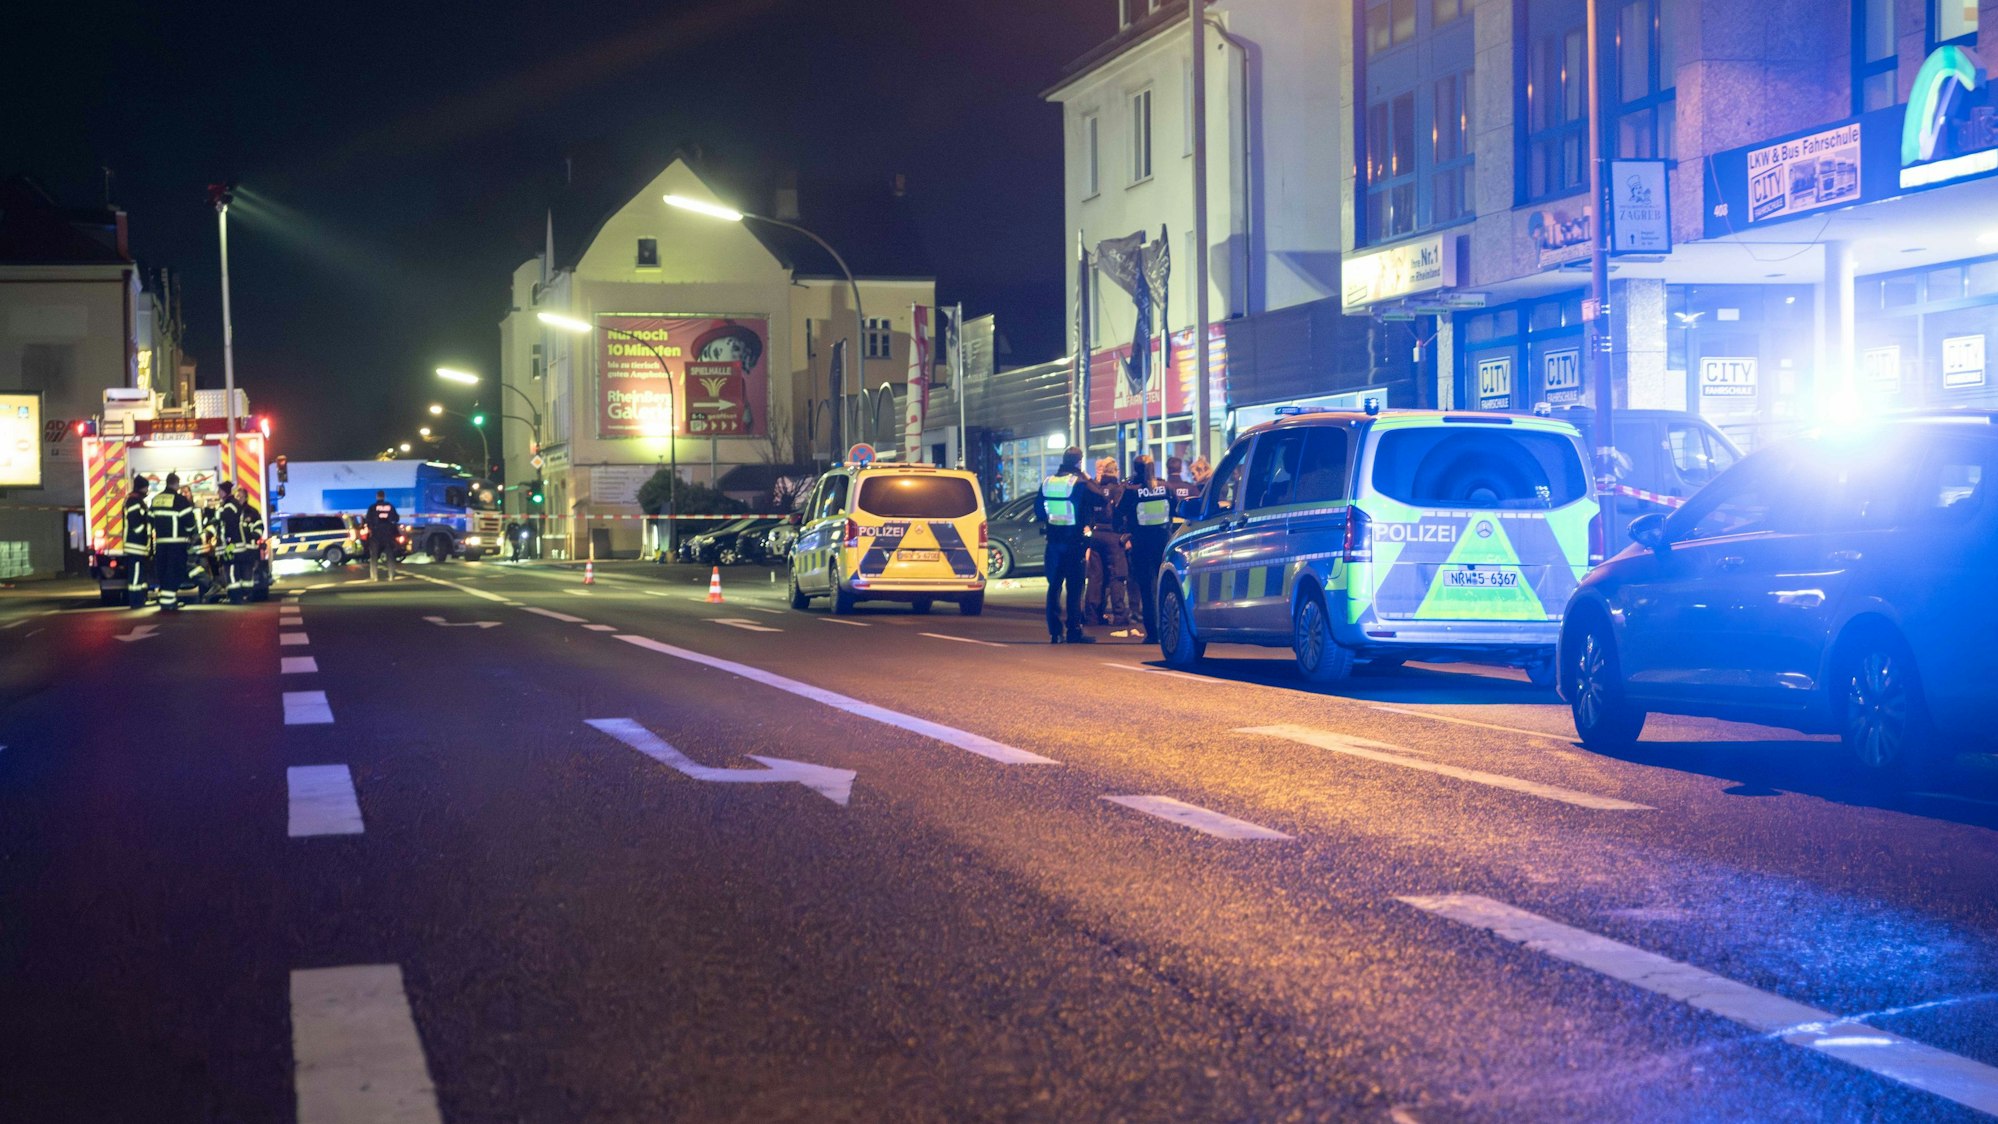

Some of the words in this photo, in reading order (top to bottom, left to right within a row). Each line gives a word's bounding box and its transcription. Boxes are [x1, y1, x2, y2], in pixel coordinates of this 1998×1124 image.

[1750, 151, 1769, 169] LKW
[1772, 148, 1779, 162] &
[1782, 145, 1799, 161] Bus
[1802, 127, 1859, 155] Fahrschule
[1753, 169, 1783, 203] CITY
[1619, 209, 1661, 221] ZAGREB
[1416, 266, 1440, 281] Rheinland
[607, 328, 633, 341] Nur
[635, 328, 668, 341] noch
[607, 344, 624, 356] 10
[625, 343, 681, 357] Minuten
[607, 361, 620, 369] bis
[690, 367, 731, 376] SPIELHALLE
[1547, 355, 1577, 386] CITY
[607, 371, 629, 379] guten
[1481, 364, 1508, 393] CITY
[1706, 363, 1752, 382] CITY
[1546, 390, 1578, 402] FAHRSCHULE
[1705, 386, 1753, 395] FAHRSCHULE
[1481, 398, 1509, 410] FAHRSCHULE
[859, 526, 904, 537] POLIZEI
[1374, 524, 1456, 542] POLIZEI
[1451, 572, 1472, 585] NRW
